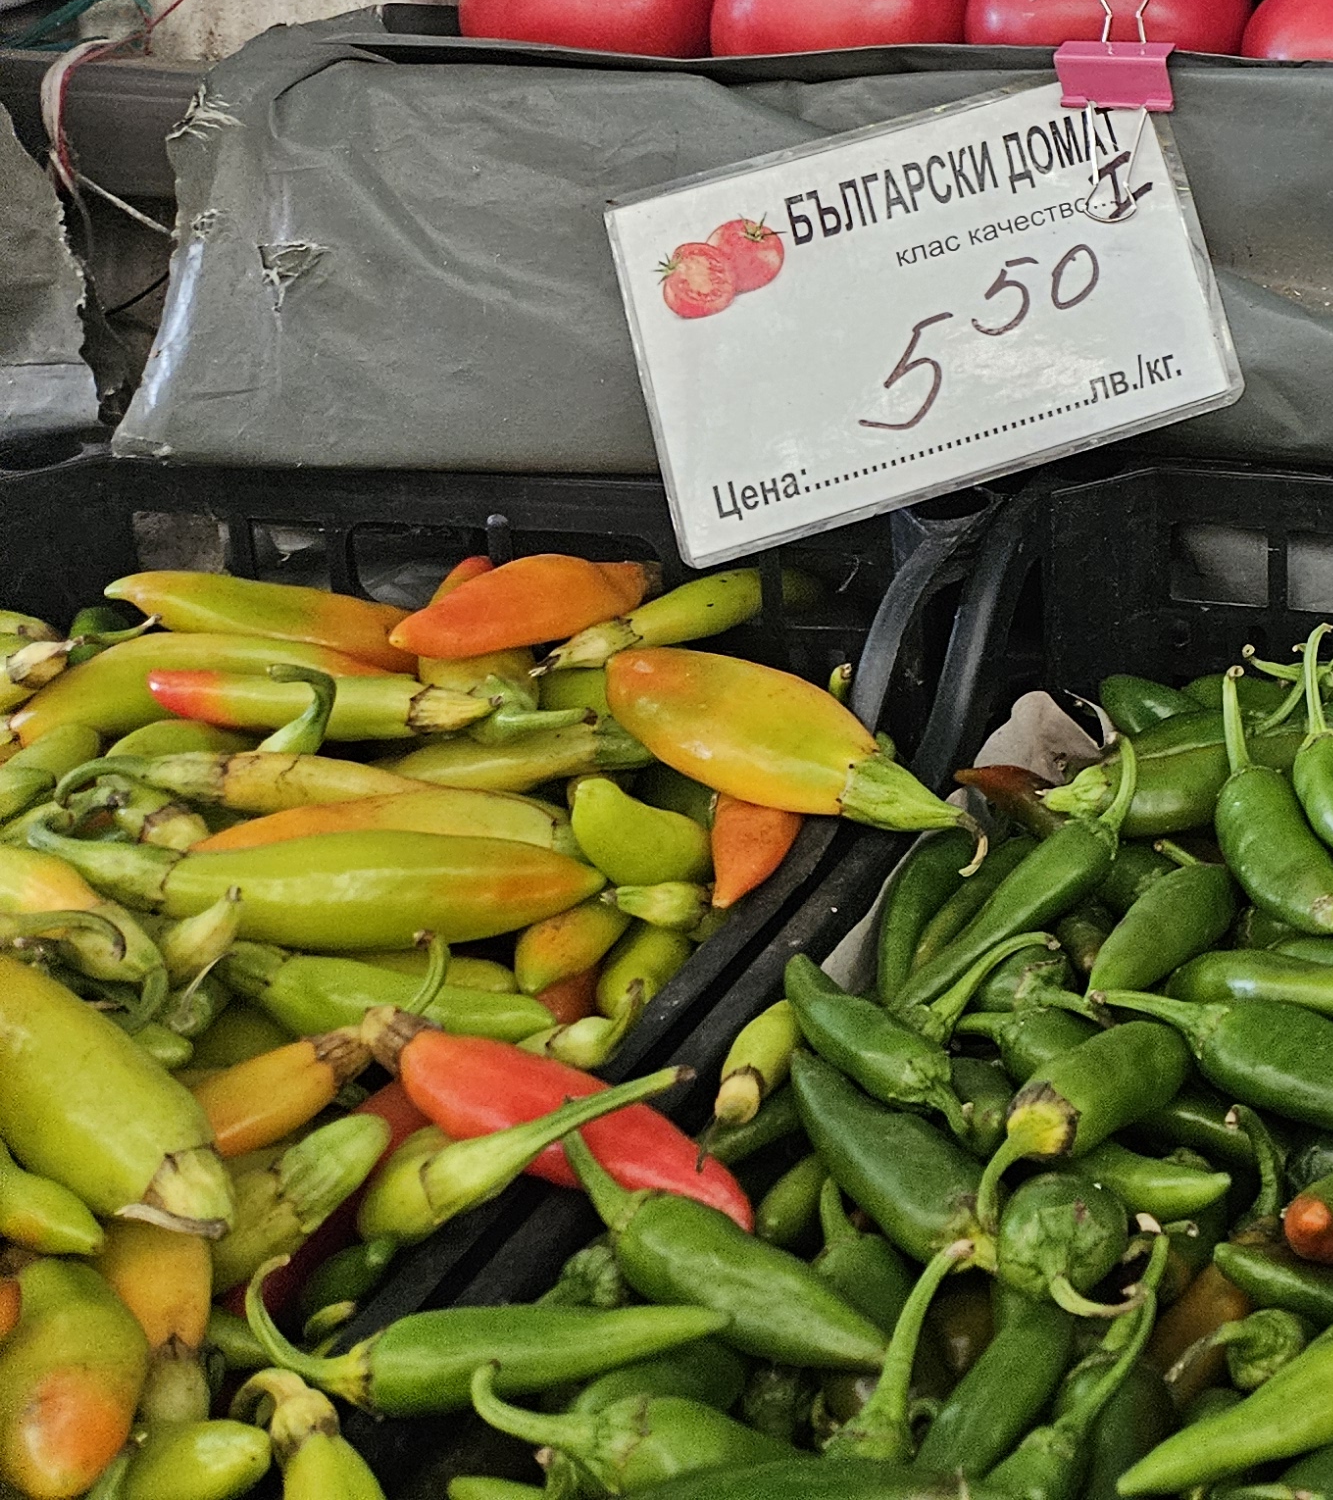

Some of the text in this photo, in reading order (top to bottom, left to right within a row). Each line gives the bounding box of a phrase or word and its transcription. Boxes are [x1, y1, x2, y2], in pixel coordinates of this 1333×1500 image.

[785, 140, 1000, 246] БЪЛГАРСКИ
[896, 235, 961, 268] клас
[857, 243, 1100, 430] 5 50
